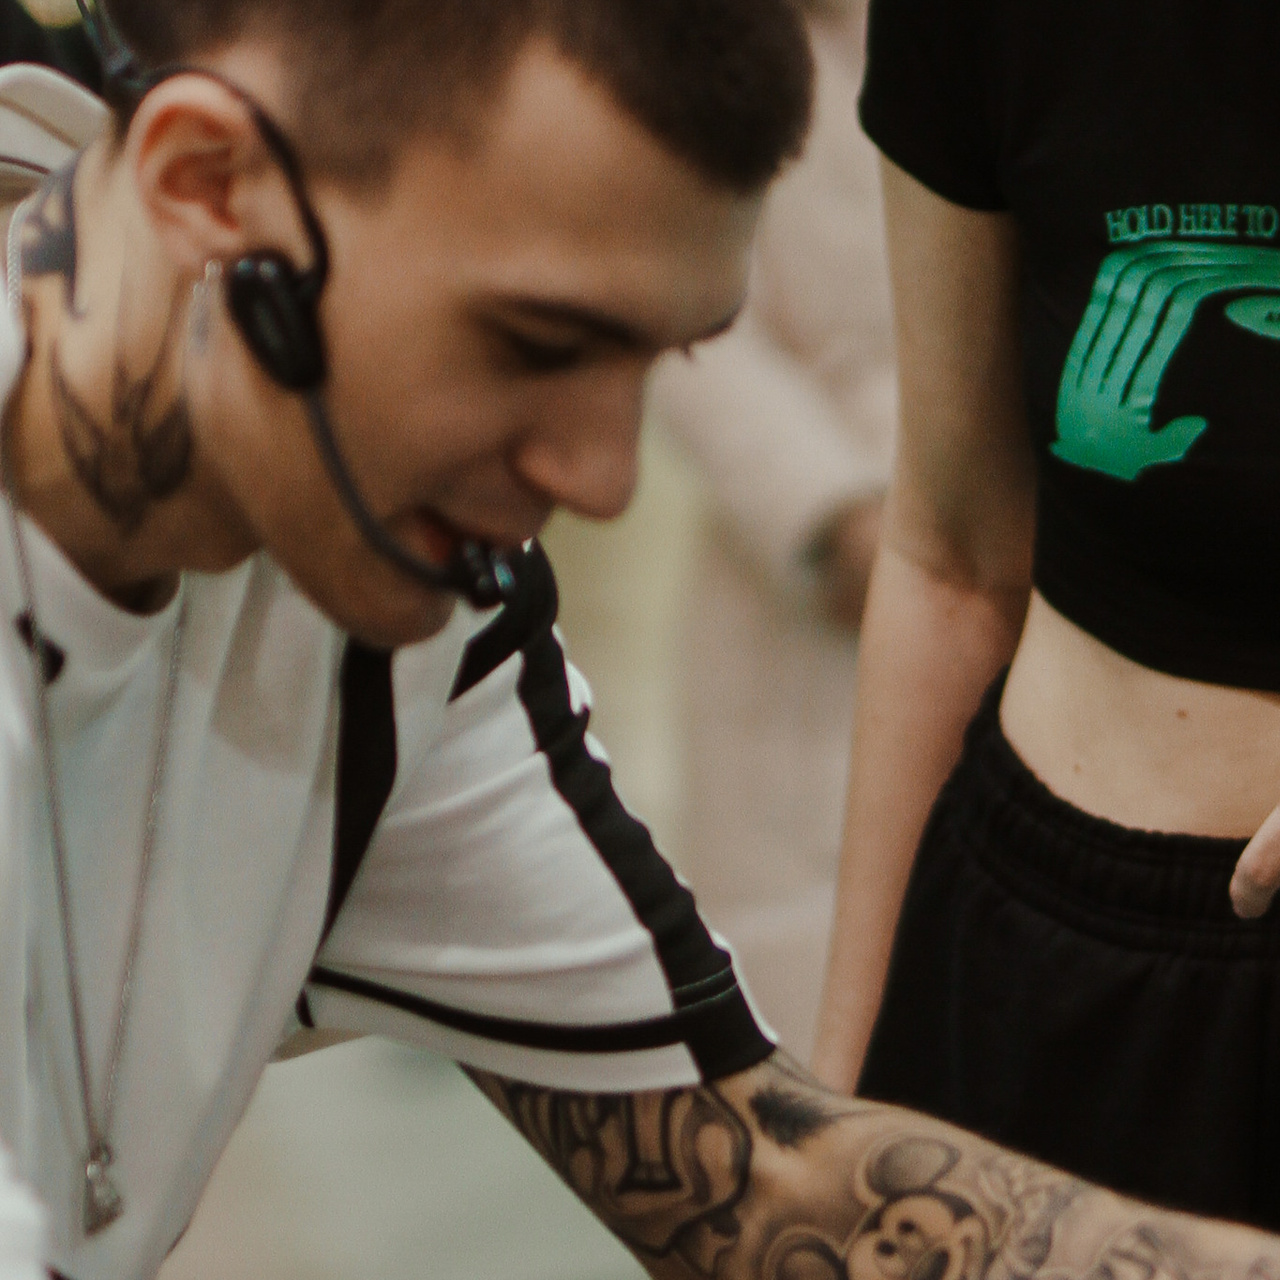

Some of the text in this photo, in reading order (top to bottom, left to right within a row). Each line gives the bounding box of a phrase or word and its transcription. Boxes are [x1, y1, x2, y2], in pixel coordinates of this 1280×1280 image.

[1105, 204, 1174, 243] HOLD
[1177, 203, 1238, 238] HERE
[1240, 204, 1279, 239] TO
